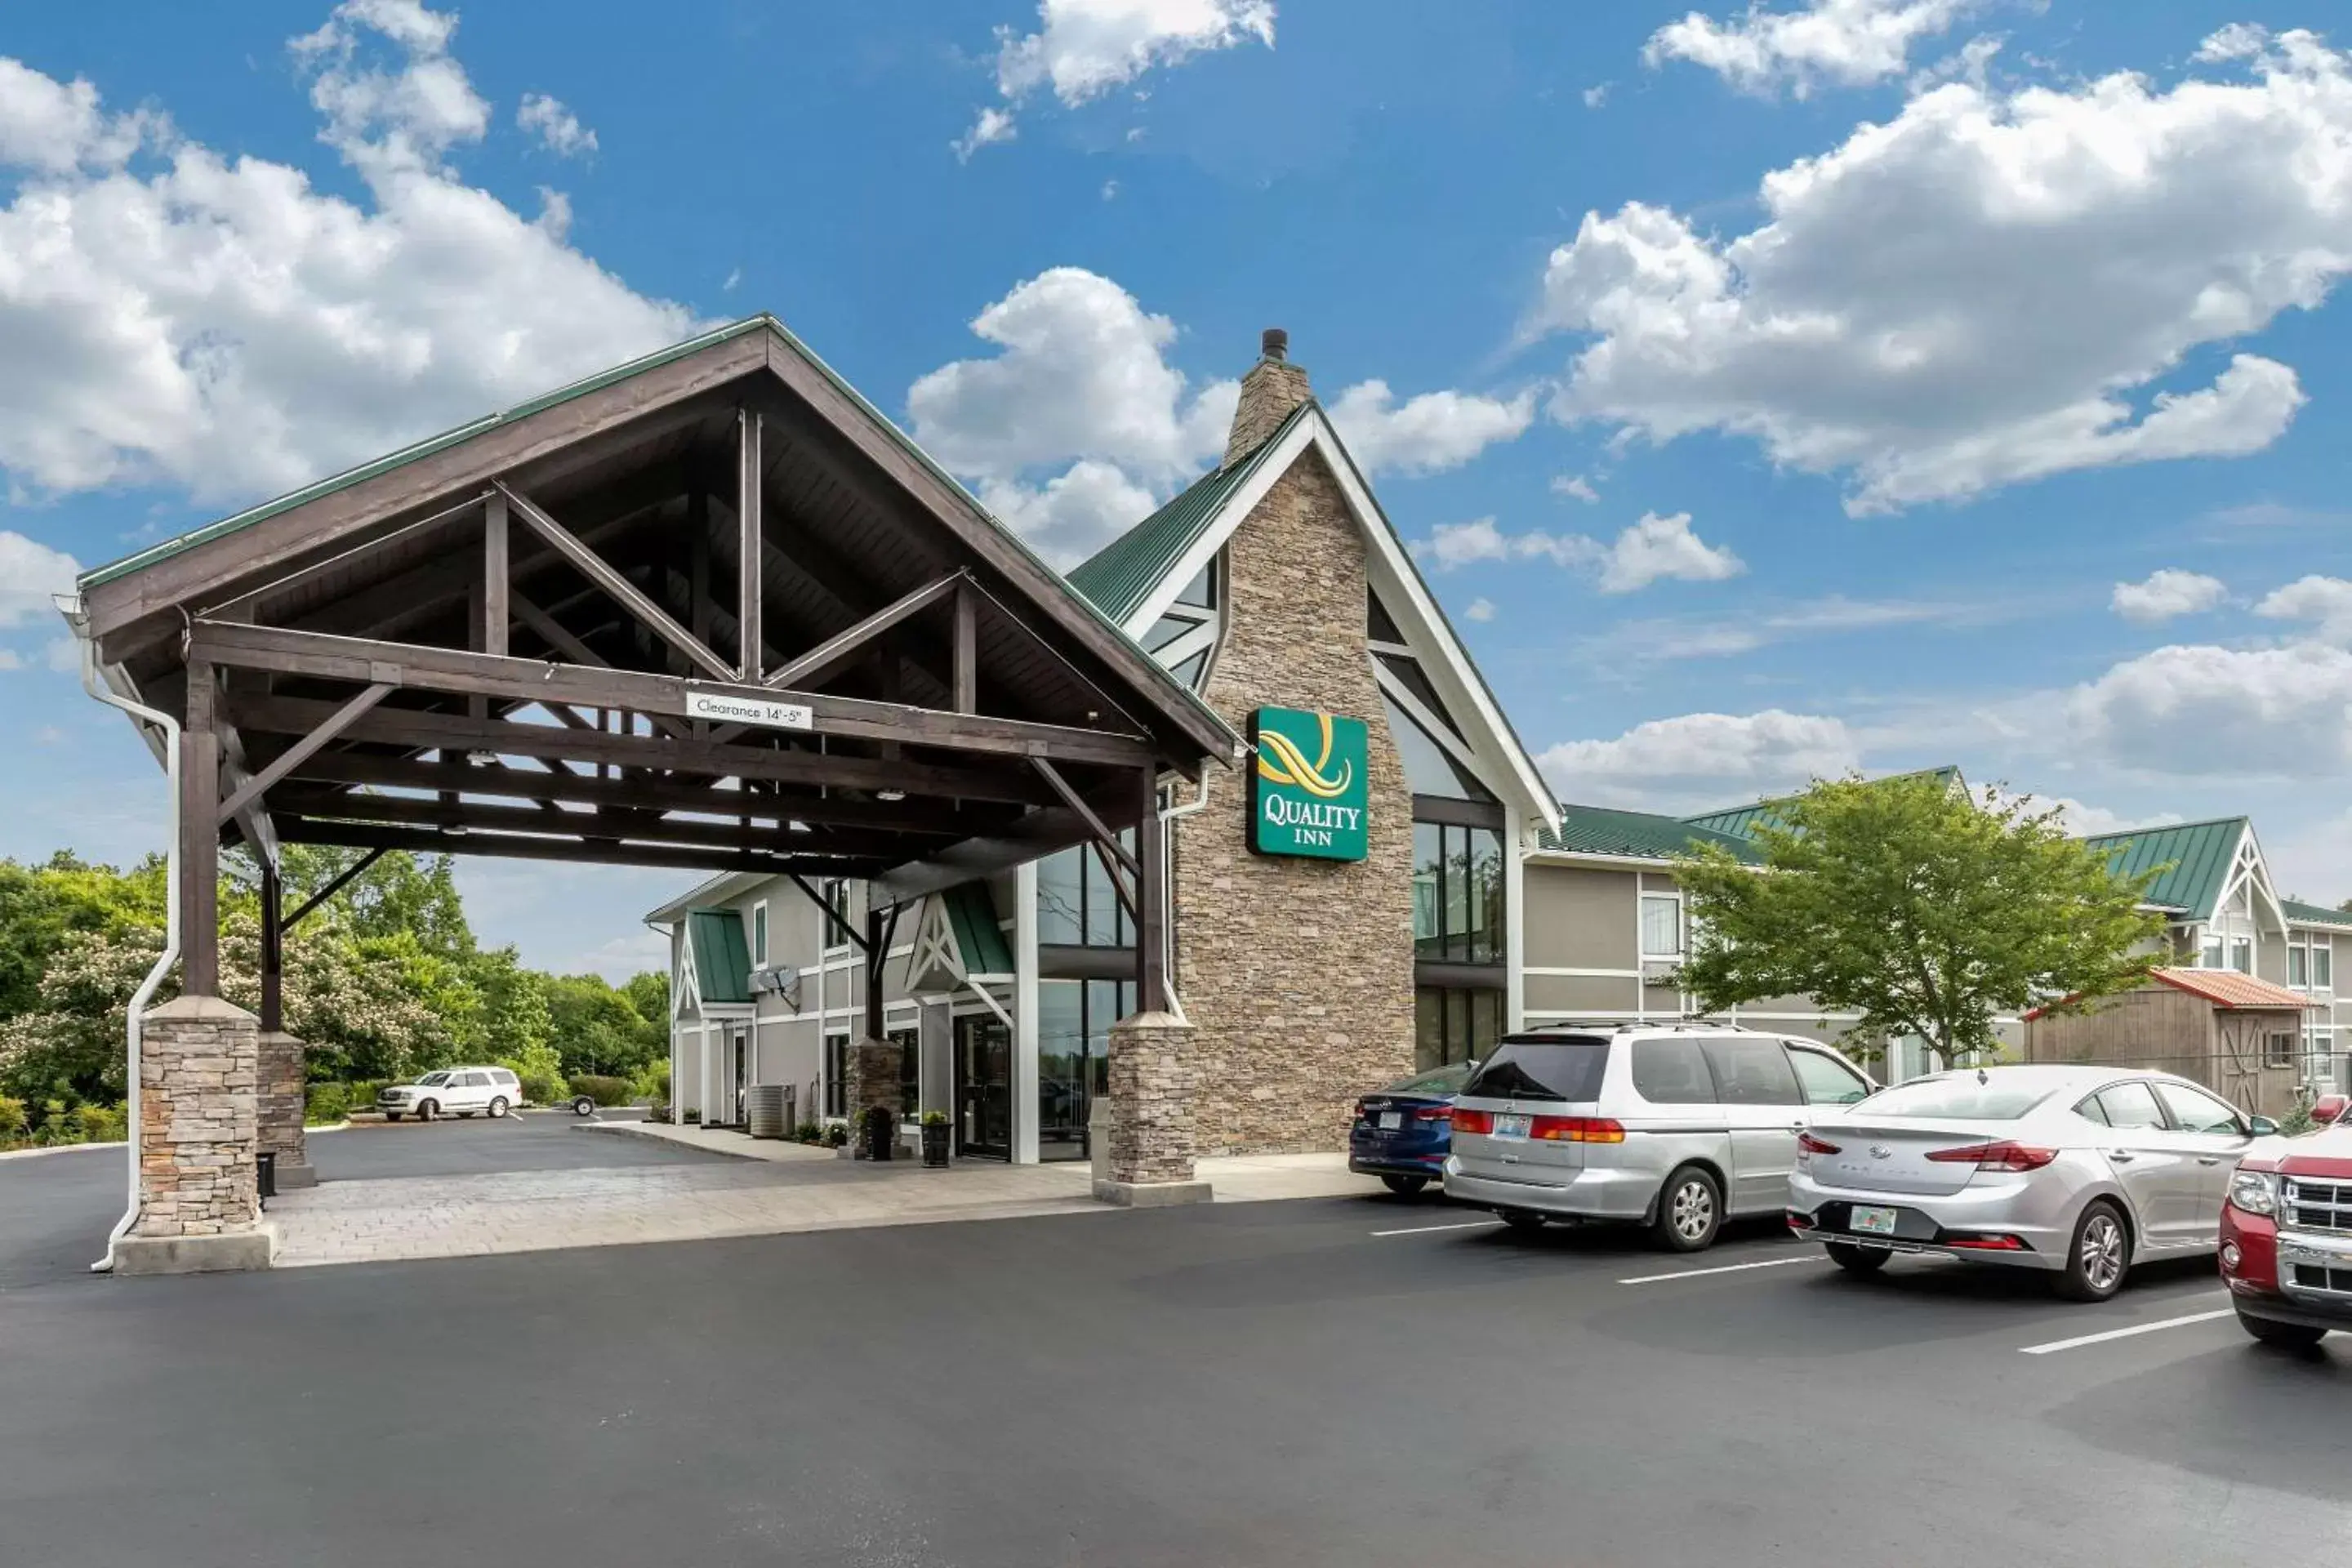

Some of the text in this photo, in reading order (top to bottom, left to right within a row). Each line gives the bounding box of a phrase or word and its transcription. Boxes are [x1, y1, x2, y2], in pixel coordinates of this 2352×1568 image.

[697, 698, 760, 717] Clearance
[1266, 794, 1361, 830] QUALITY
[1294, 829, 1332, 847] INN
